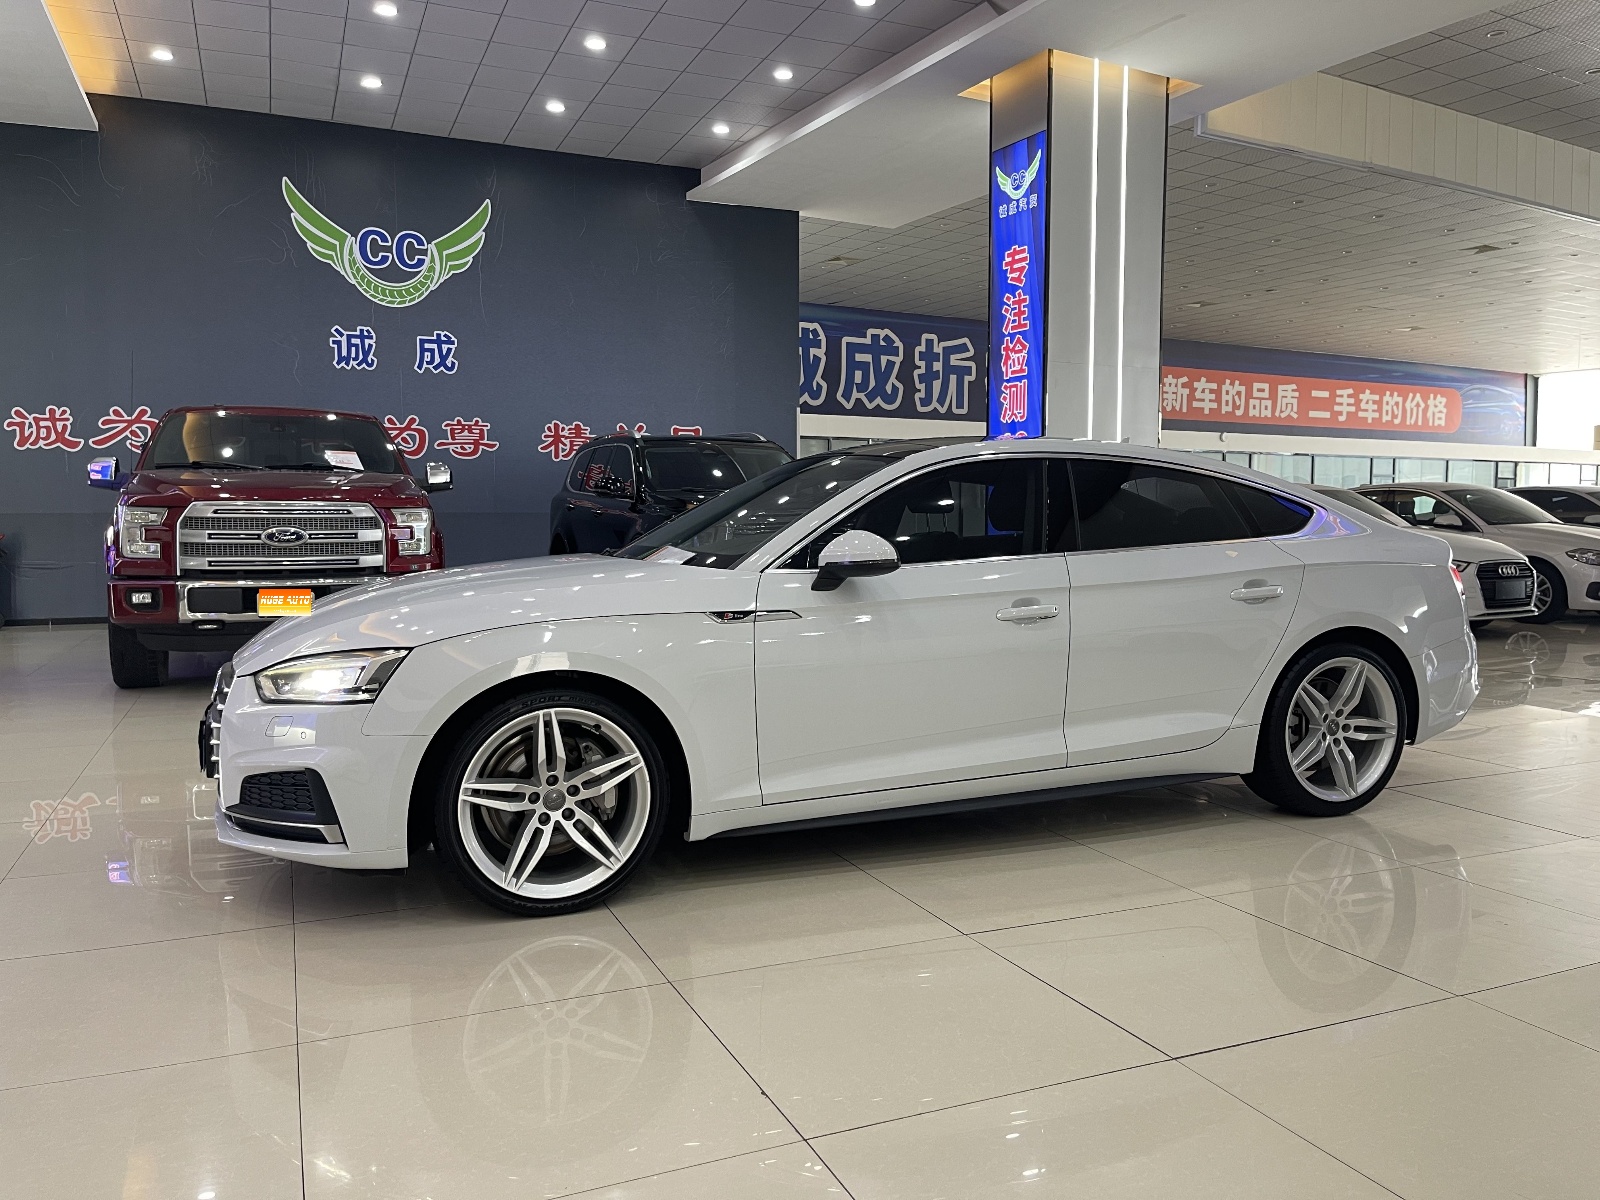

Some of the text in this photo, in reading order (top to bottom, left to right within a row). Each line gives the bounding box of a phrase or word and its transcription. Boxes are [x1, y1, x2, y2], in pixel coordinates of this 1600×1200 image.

[356, 227, 428, 272] CC
[799, 321, 988, 414] 成折
[1000, 245, 1029, 423] 专注检测
[1162, 374, 1447, 427] 新车的品质 二手车的价格
